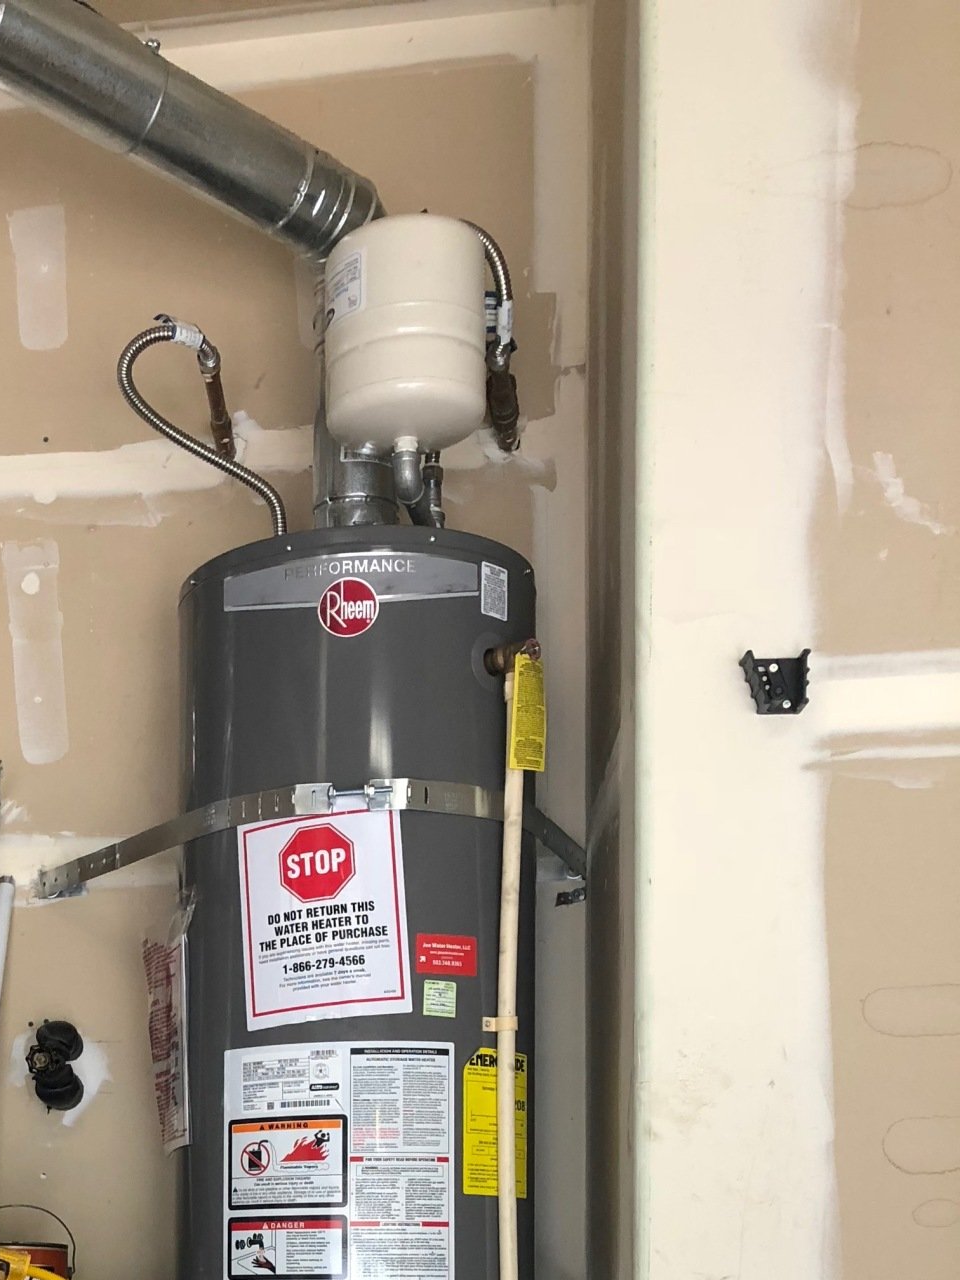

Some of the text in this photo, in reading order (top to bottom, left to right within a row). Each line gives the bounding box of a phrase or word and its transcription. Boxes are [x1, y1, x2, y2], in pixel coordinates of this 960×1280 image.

[284, 559, 417, 580] PERFORMANCE
[326, 580, 375, 628] Rheem
[286, 848, 346, 879] STOP
[267, 900, 375, 926] DO NOT RETURN THIS
[274, 914, 369, 937] WATER HEATER TO
[259, 925, 389, 953] THE PLACE OF PURCHASE
[282, 954, 366, 975] 1-866-279-4566
[268, 1121, 309, 1130] WARNING
